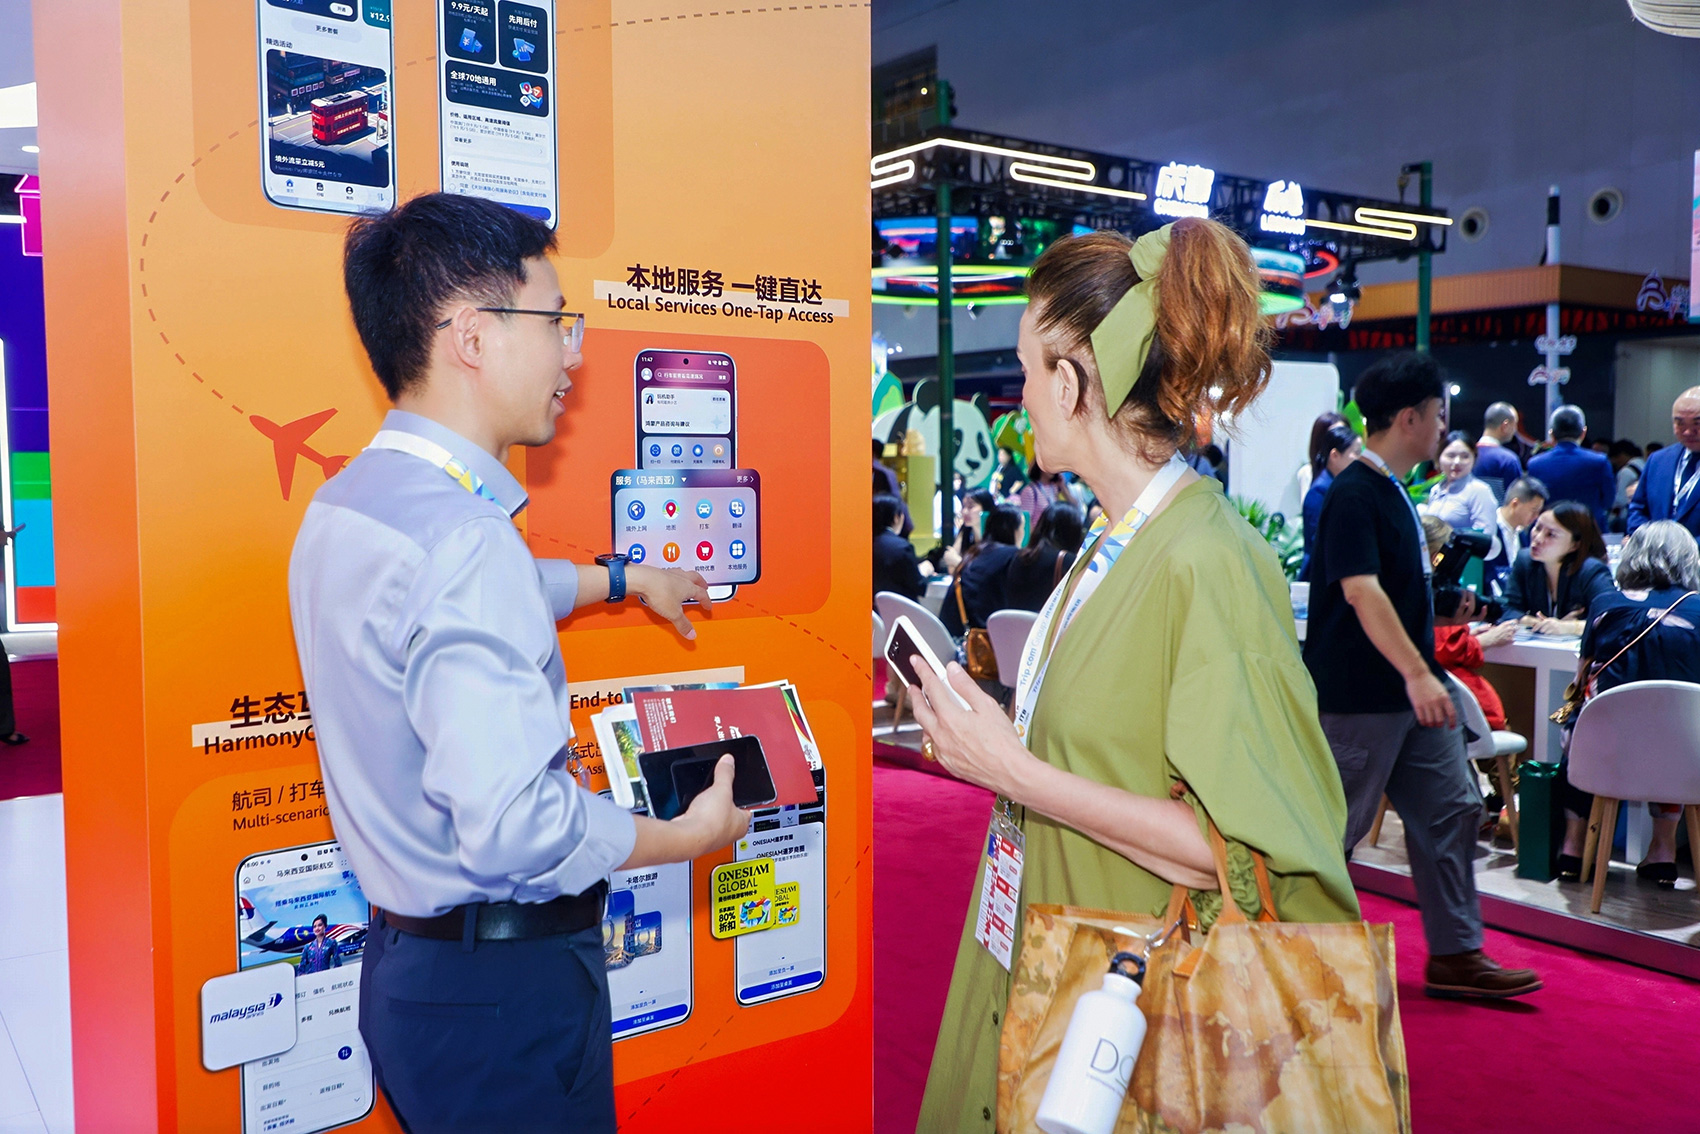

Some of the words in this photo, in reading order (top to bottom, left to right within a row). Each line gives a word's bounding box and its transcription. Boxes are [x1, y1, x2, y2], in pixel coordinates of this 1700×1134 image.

[508, 14, 538, 28] 先用后付
[450, 70, 497, 87] 全球70地通用
[626, 263, 725, 298] 本地服务
[731, 274, 823, 306] 一键直达
[608, 293, 650, 311] Local
[655, 297, 717, 316] Services
[722, 302, 783, 324] One-Tap
[788, 307, 834, 324] Access
[736, 475, 749, 483] 更多
[1020, 647, 1037, 687] Trip.com
[232, 787, 272, 812] 航司
[289, 779, 325, 803] 打车
[276, 861, 334, 878] 马来西亚国际航空
[718, 863, 770, 883] ONESIAM
[717, 877, 758, 895] GLOBAL
[775, 885, 797, 896] ESIAM
[718, 911, 737, 922] 80%
[718, 920, 737, 933] 折扣
[209, 1001, 267, 1025] malaysia
